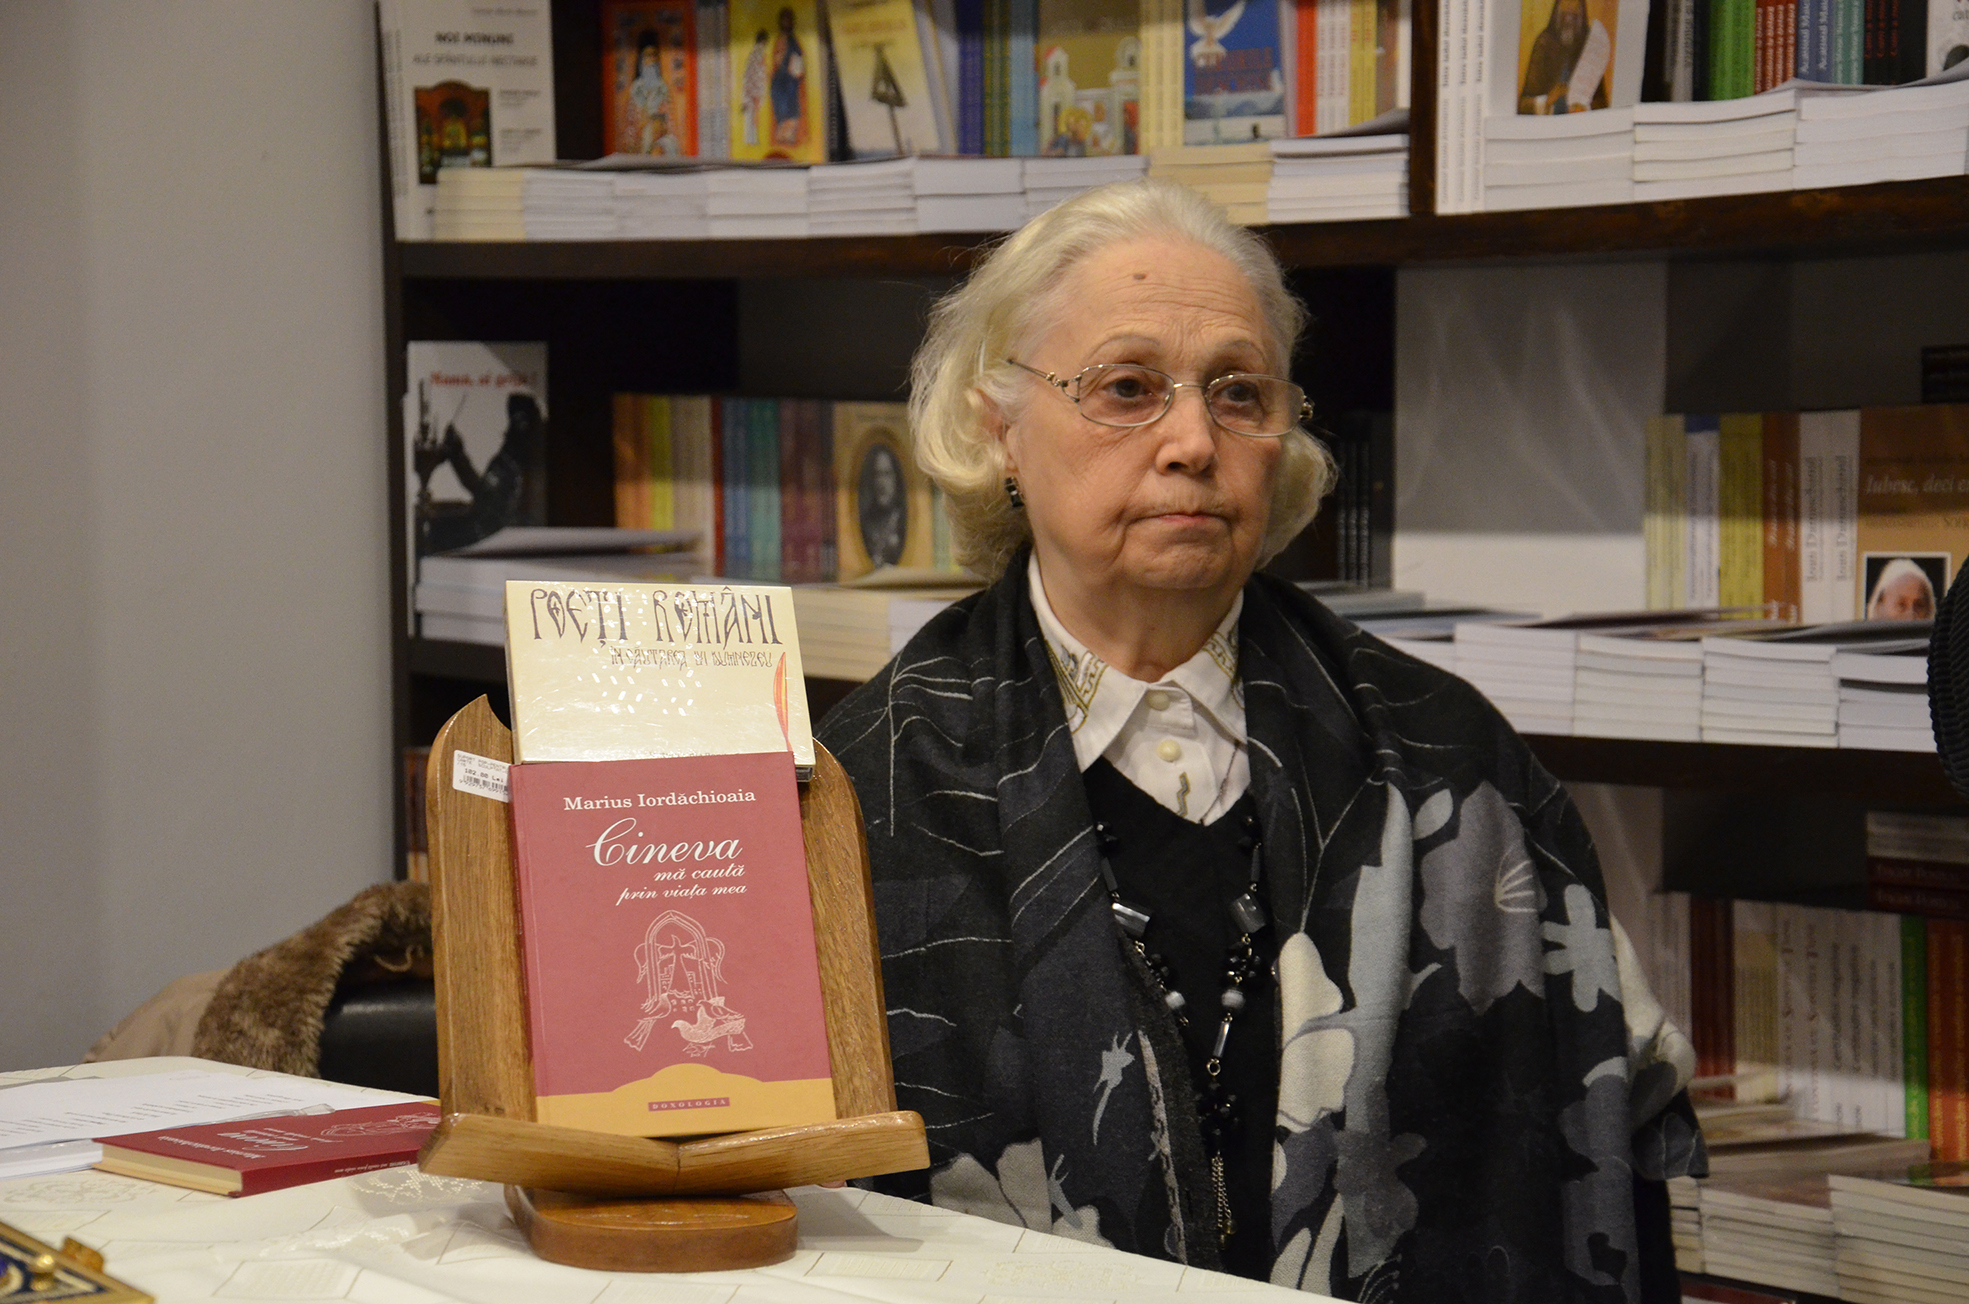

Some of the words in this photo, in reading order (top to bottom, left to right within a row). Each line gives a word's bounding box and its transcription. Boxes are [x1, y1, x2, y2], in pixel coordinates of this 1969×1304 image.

[652, 586, 783, 650] ROMÂNI
[563, 794, 633, 811] Marius
[637, 788, 756, 808] Iordăchioaia
[586, 817, 743, 866] Cineva
[654, 868, 687, 882] mă
[692, 863, 745, 880] caută
[616, 887, 658, 906] prin
[662, 883, 707, 900] viața
[712, 883, 747, 896] mea
[652, 1100, 726, 1110] DOXOLOGIA
